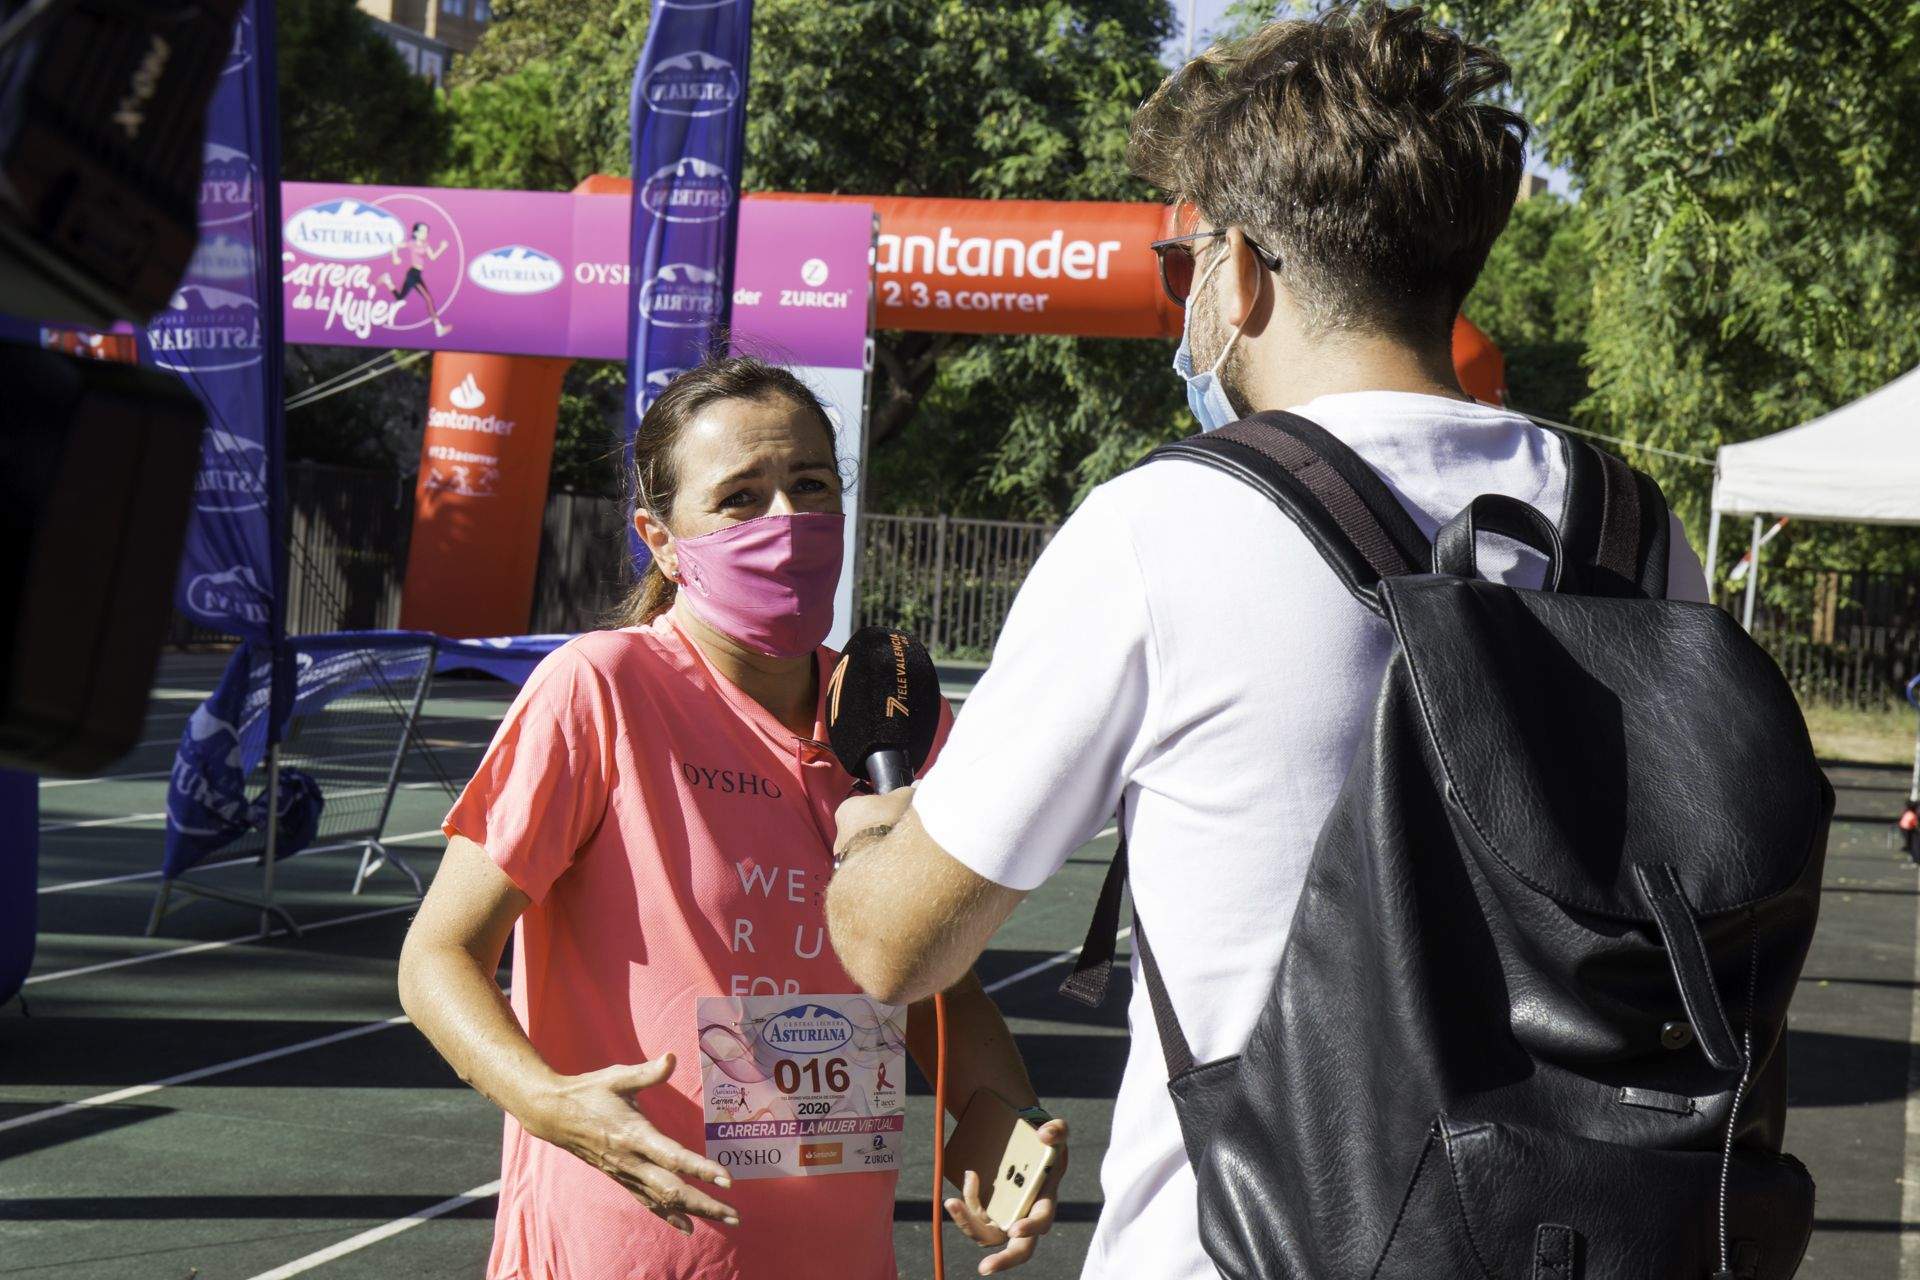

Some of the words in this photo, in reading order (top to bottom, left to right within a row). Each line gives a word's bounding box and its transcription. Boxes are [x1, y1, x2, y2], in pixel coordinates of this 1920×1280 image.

[295, 222, 395, 246] ASTURIANA
[867, 226, 1121, 280] antander
[479, 264, 555, 282] ASTURIANA
[574, 262, 630, 285] OYS
[779, 289, 848, 309] ZURICH
[323, 284, 407, 340] Mujer
[428, 407, 516, 436] Santander
[683, 763, 782, 799] OYSHO
[736, 861, 805, 903] WE
[769, 1022, 847, 1043] ASTURIANA
[773, 1057, 851, 1095] 016
[798, 1102, 831, 1115] 2020
[717, 1123, 776, 1138] CARRERA
[780, 1122, 797, 1136] DE
[799, 1121, 815, 1135] LA
[817, 1119, 856, 1134] MUJER
[858, 1116, 895, 1132] VIRTUAL
[717, 1148, 782, 1167] OYSHO
[864, 1154, 894, 1165] ZURICH
